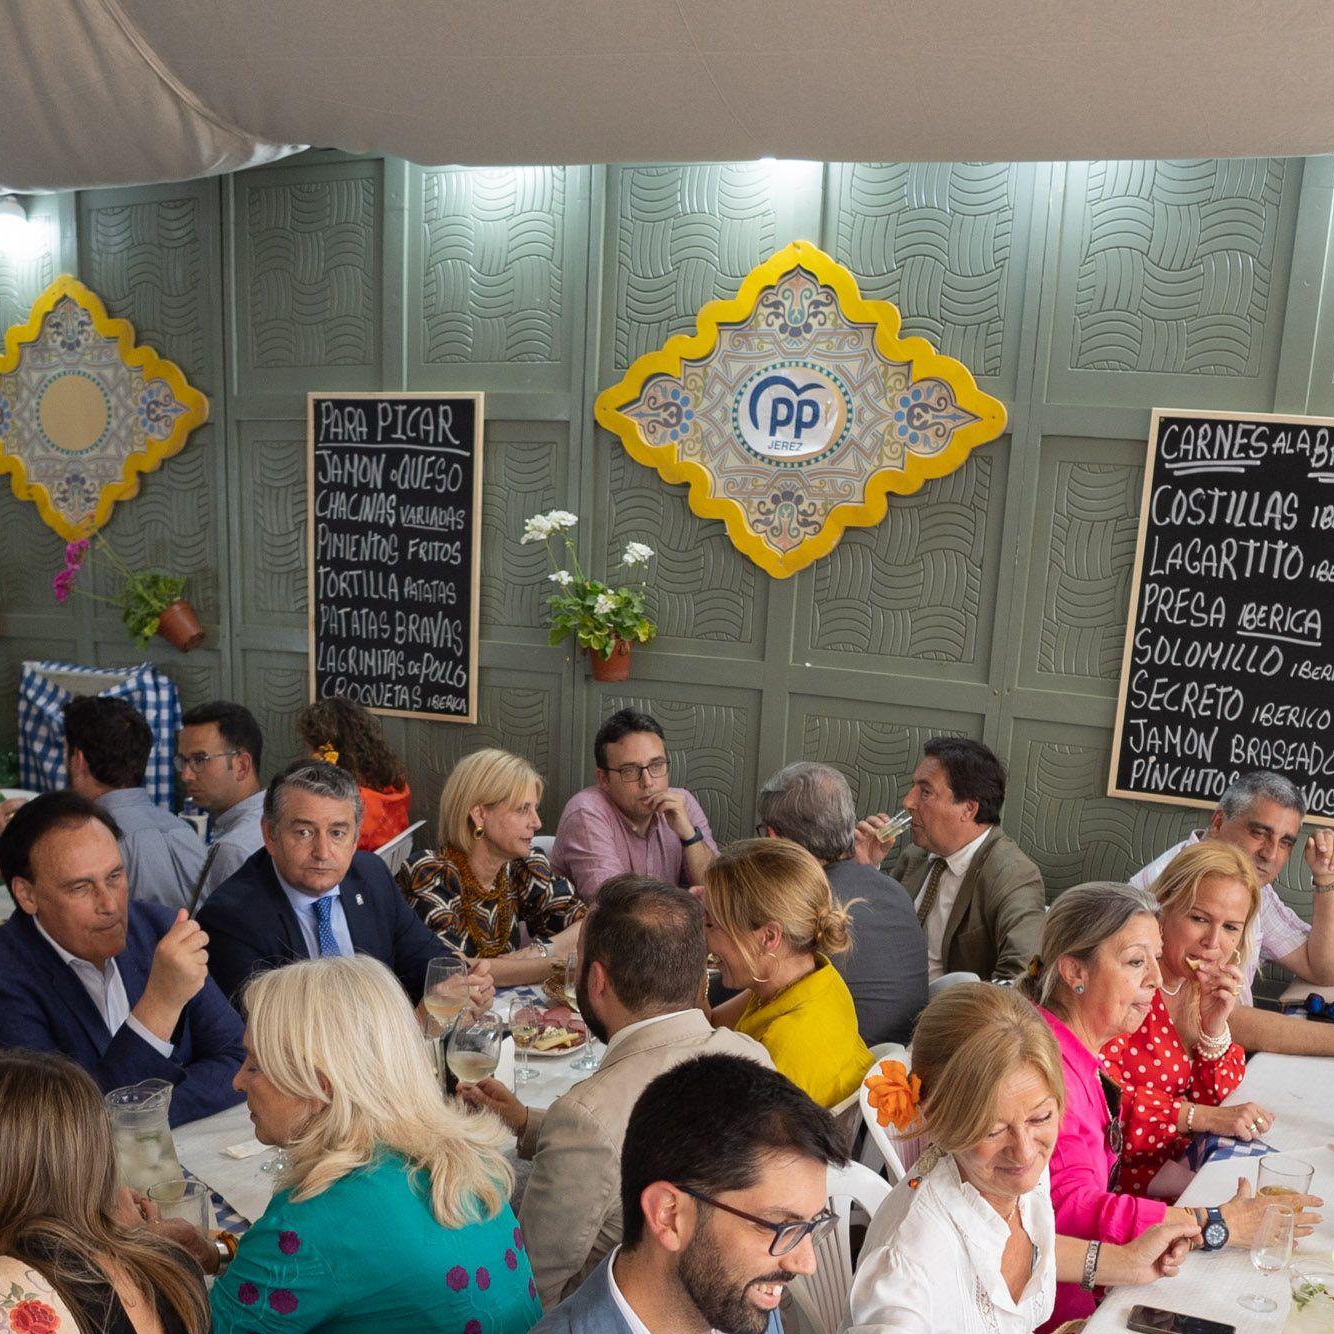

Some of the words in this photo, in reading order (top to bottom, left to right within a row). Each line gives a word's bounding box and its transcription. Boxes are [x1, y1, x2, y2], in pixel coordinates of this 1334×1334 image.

[319, 401, 368, 442] PARA
[376, 402, 460, 444] PICAR
[1161, 423, 1269, 460] CARNES
[768, 440, 803, 451] JEREZ
[315, 450, 386, 489] JAMON
[397, 454, 463, 493] QUESO
[316, 489, 397, 527] CHACINAS
[400, 504, 466, 531] VARIADAS
[1151, 485, 1298, 531] COSTILLAS
[317, 523, 399, 565] PIMIENTOS
[407, 538, 462, 565] FRITOS
[1149, 536, 1304, 581] LAGARTITO
[318, 565, 399, 602] TORTILLA
[404, 576, 456, 604] PATATAS
[319, 603, 391, 640] PATATAS
[395, 610, 463, 657] BRAVAS
[1140, 583, 1226, 628] PRESA
[1238, 602, 1322, 639] IBERICA
[317, 642, 405, 680] LAGRIMITAS
[420, 652, 467, 689] POLLO
[1134, 627, 1284, 676] SOLOMILLO
[321, 675, 422, 711] CROQUETAS
[1131, 669, 1244, 721] SECRETO
[1251, 702, 1332, 730] IBERICO
[1129, 718, 1219, 763] JAMON
